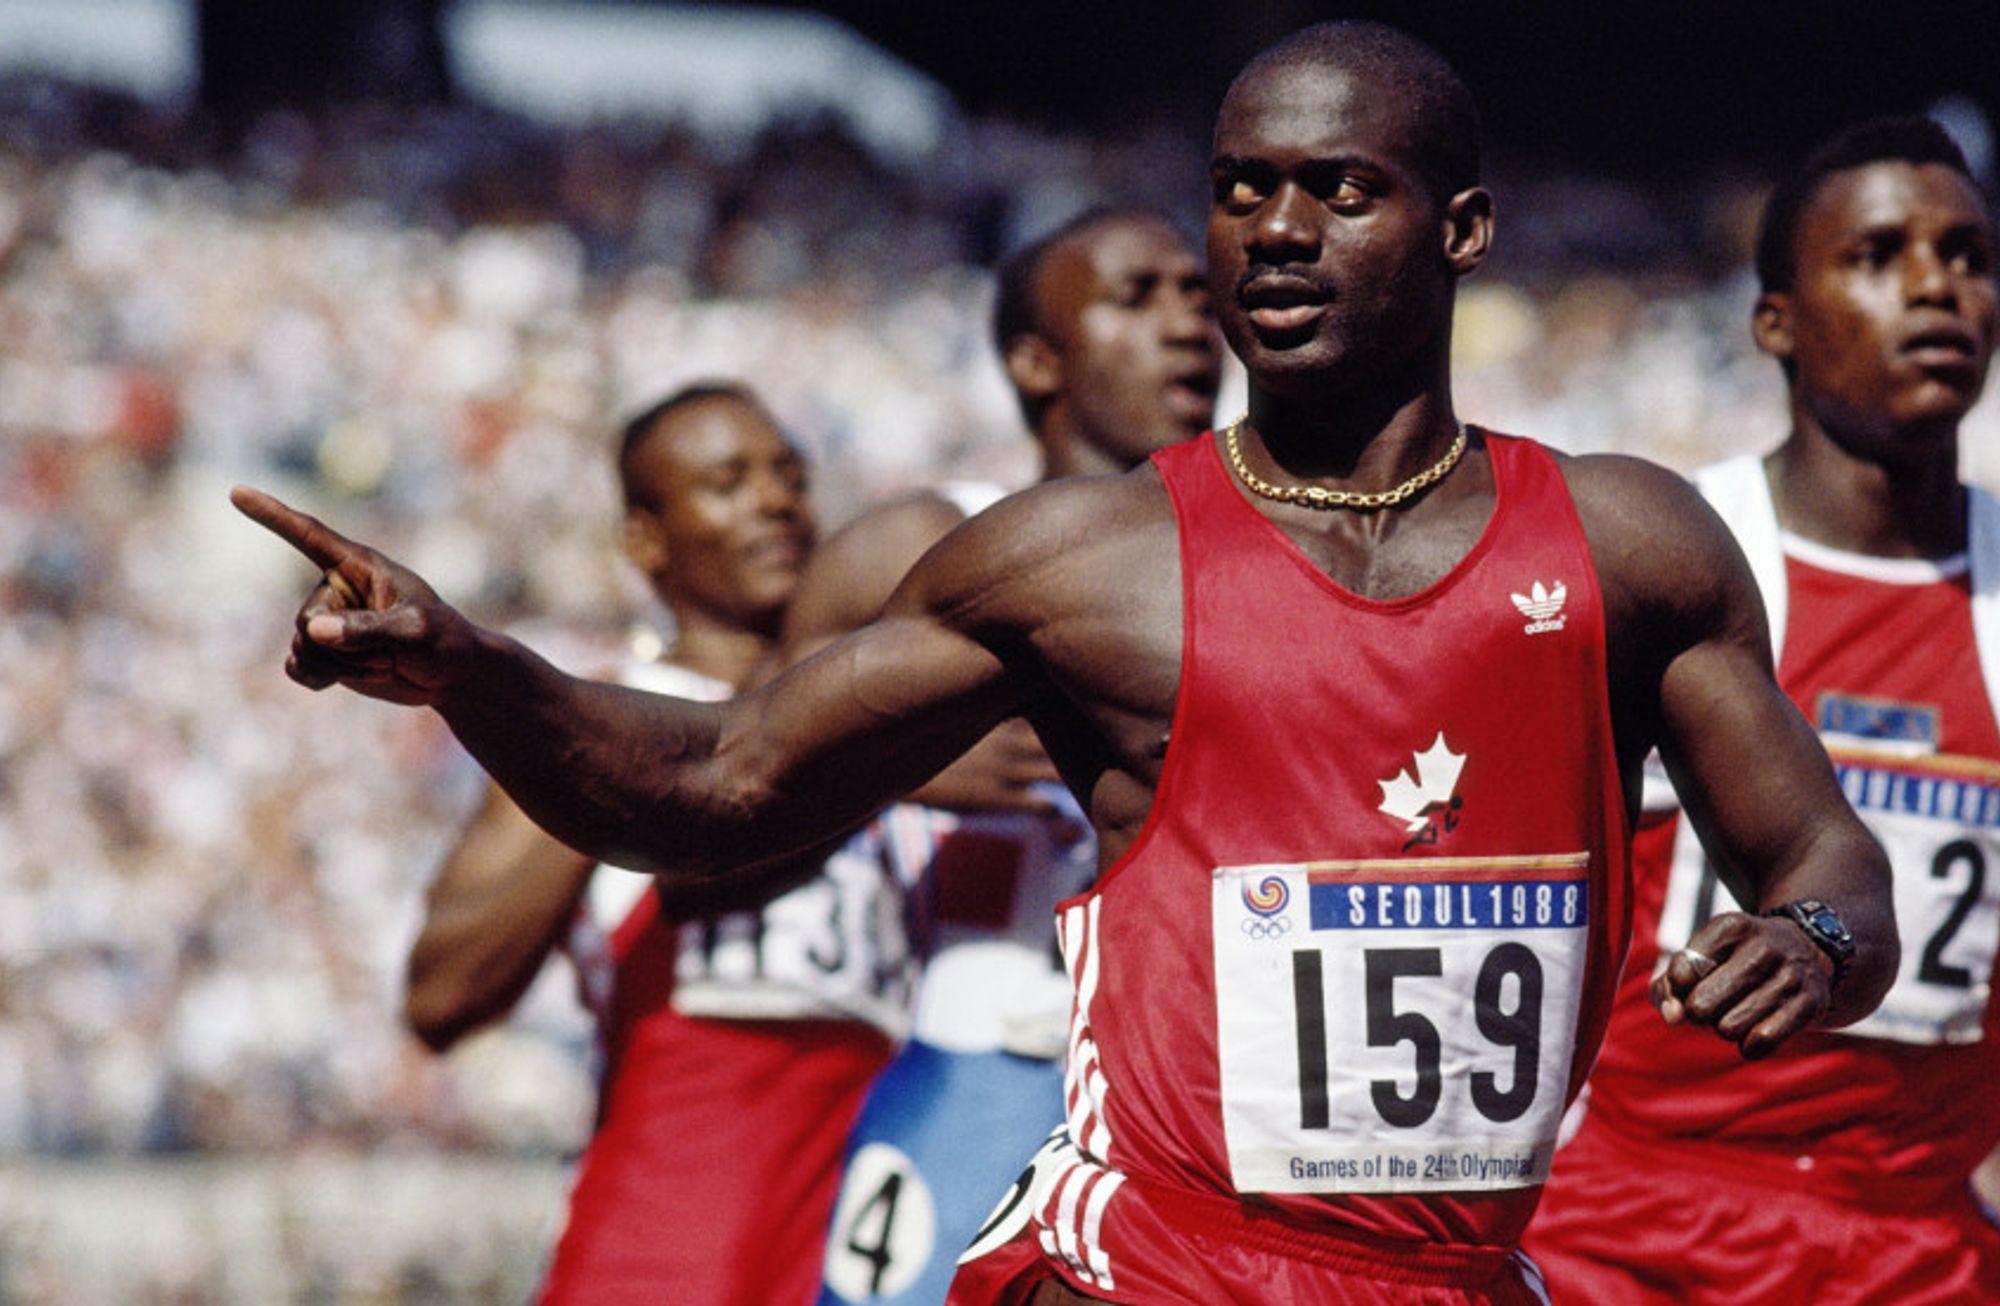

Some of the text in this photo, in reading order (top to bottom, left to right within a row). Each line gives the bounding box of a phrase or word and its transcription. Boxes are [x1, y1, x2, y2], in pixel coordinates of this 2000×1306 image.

[1292, 941, 1544, 1130] 159
[1290, 1155, 1358, 1180] Games
[1363, 1155, 1382, 1177] of
[1389, 1155, 1417, 1177] the
[848, 1173, 902, 1296] 4
